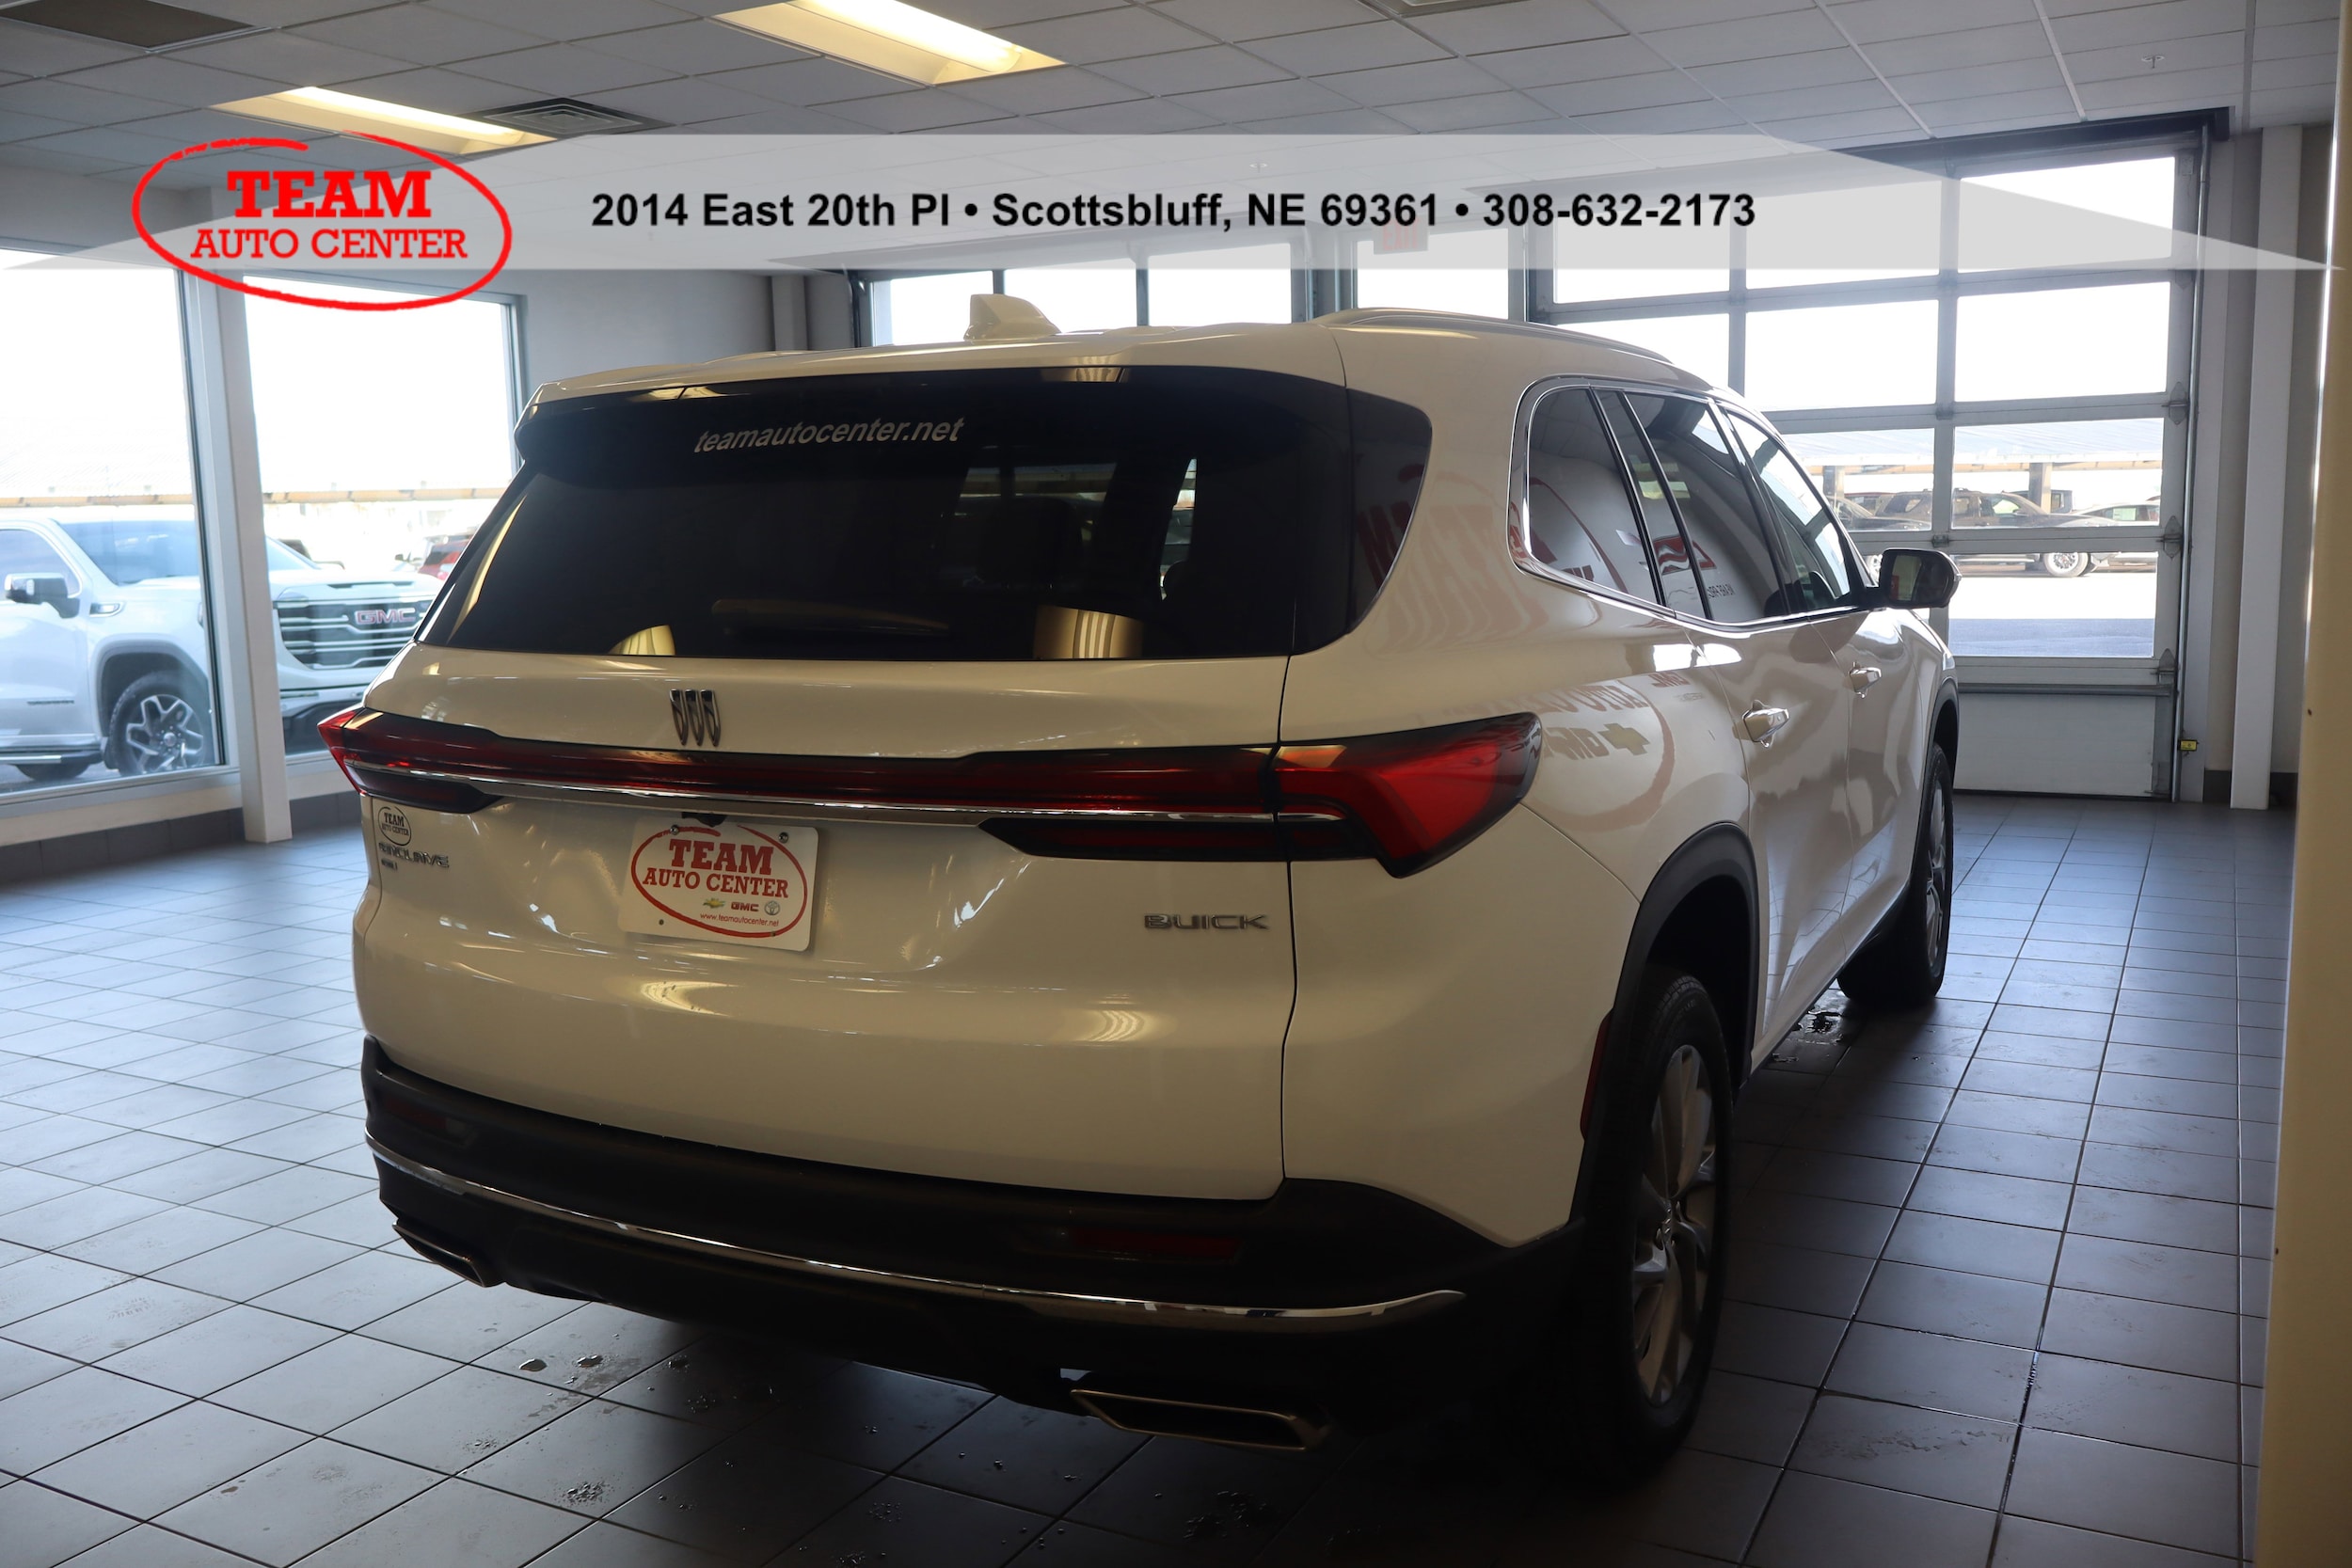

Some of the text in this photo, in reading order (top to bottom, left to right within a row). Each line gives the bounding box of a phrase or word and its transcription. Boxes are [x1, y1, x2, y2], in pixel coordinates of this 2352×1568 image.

[694, 418, 964, 453] teamautocenter.net
[355, 607, 416, 625] GMC
[384, 812, 405, 827] TEAM
[669, 838, 774, 876] TEAM
[642, 867, 789, 898] AUTO CENTER
[731, 901, 759, 912] GMC
[699, 911, 779, 927] www.teamautocenter.net
[1144, 913, 1269, 929] BUICK
